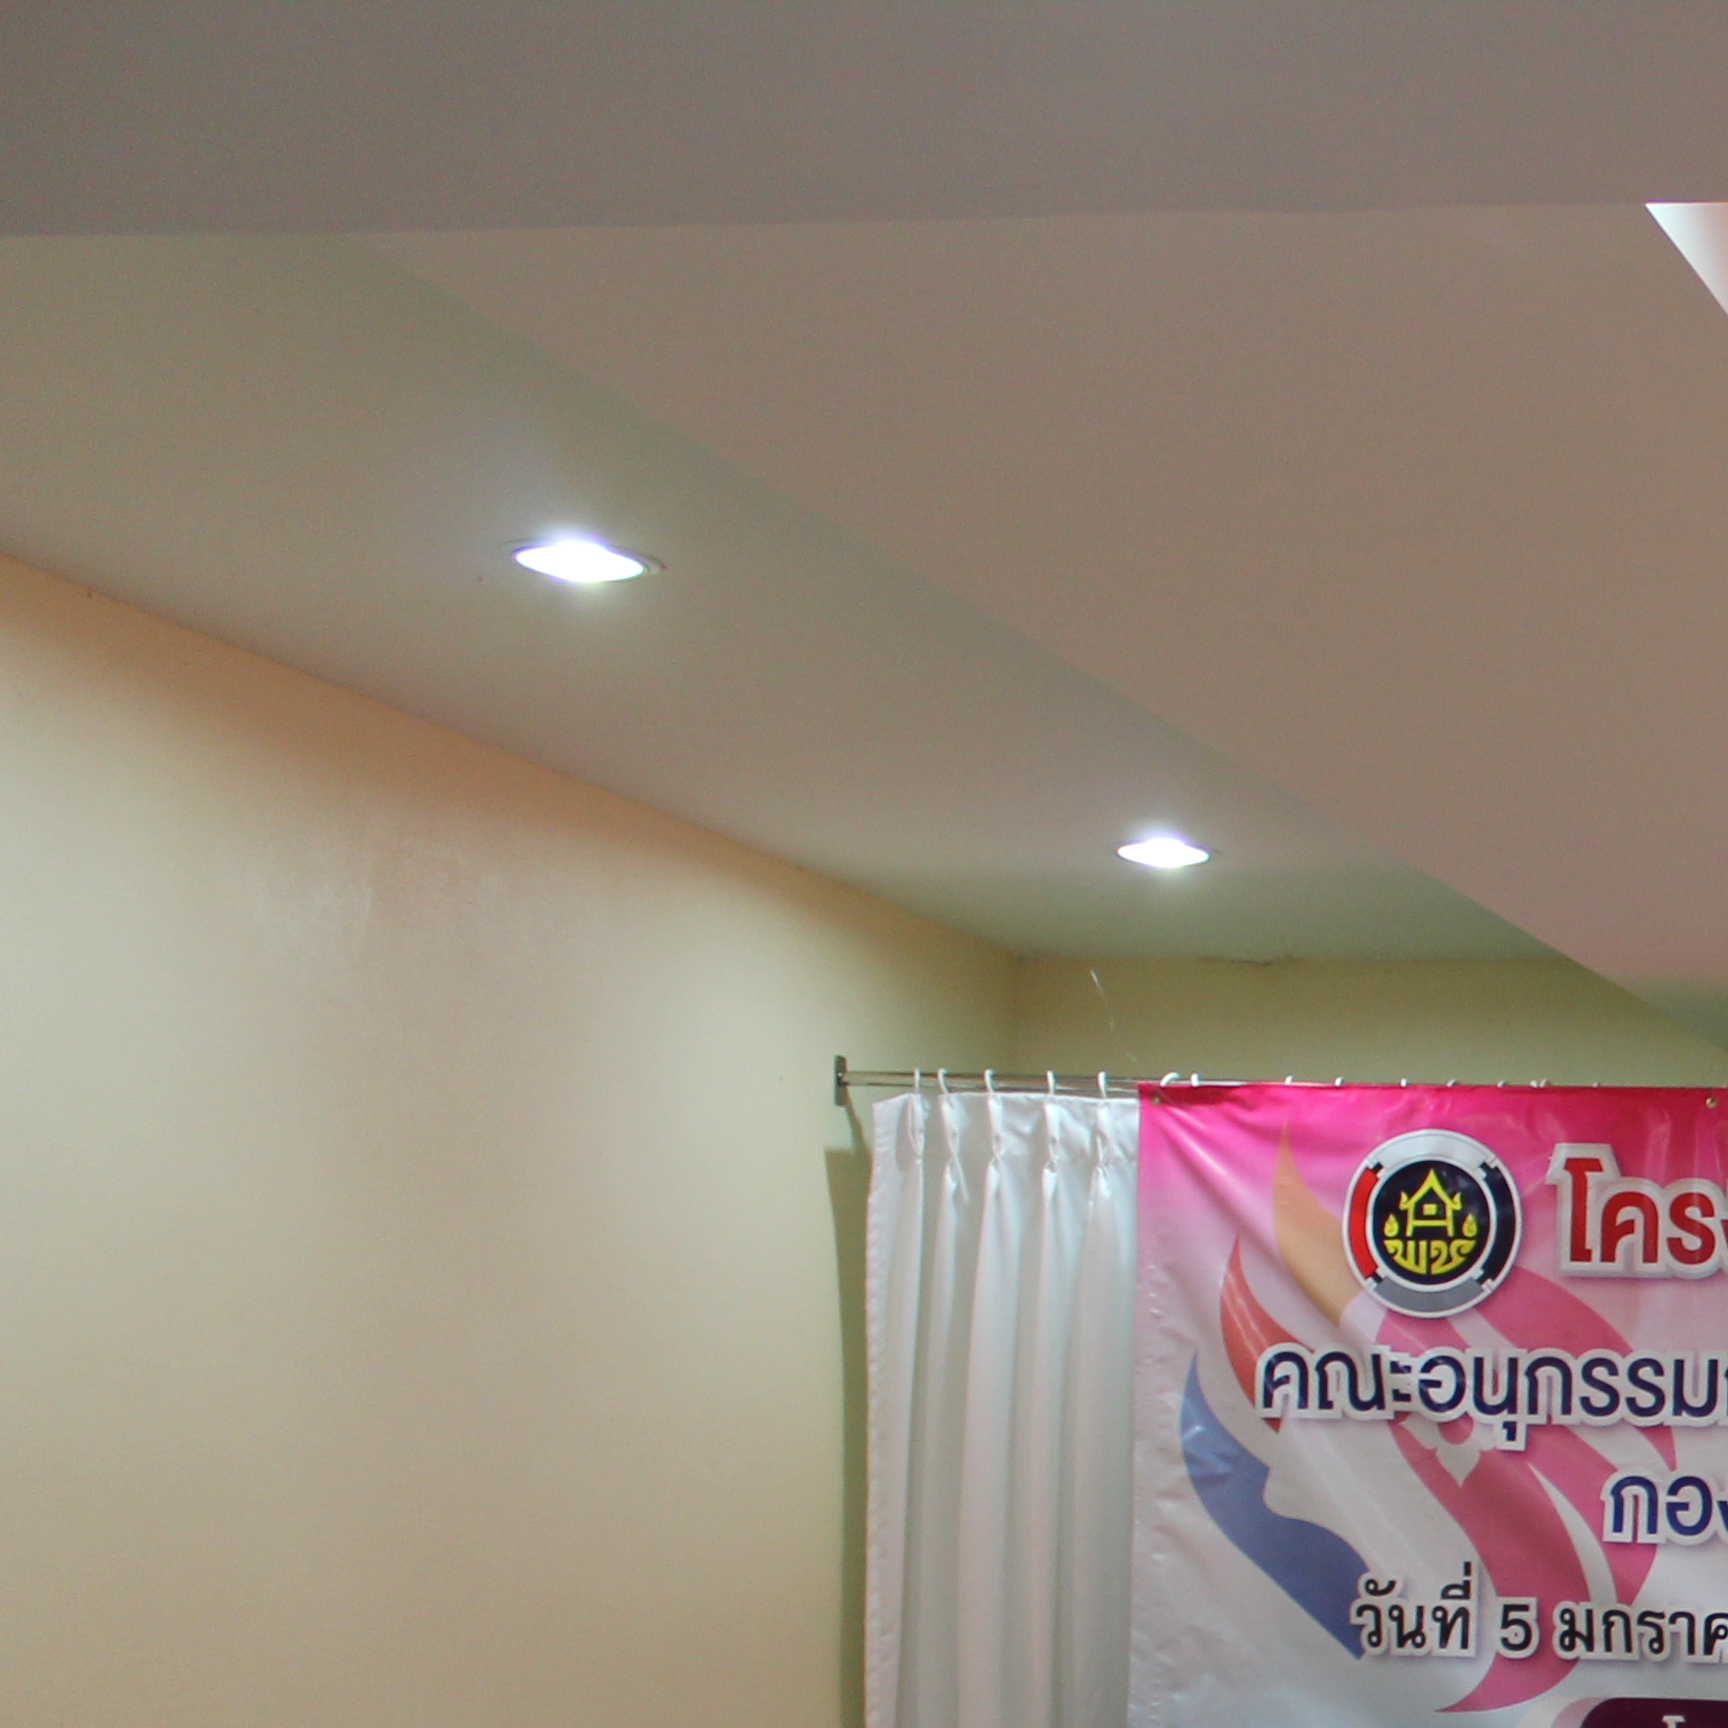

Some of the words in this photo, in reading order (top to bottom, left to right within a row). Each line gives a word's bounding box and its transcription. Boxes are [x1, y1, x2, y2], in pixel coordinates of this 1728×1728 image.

[1355, 1562, 1473, 1651] วันที่
[1500, 1602, 1535, 1652] 5
